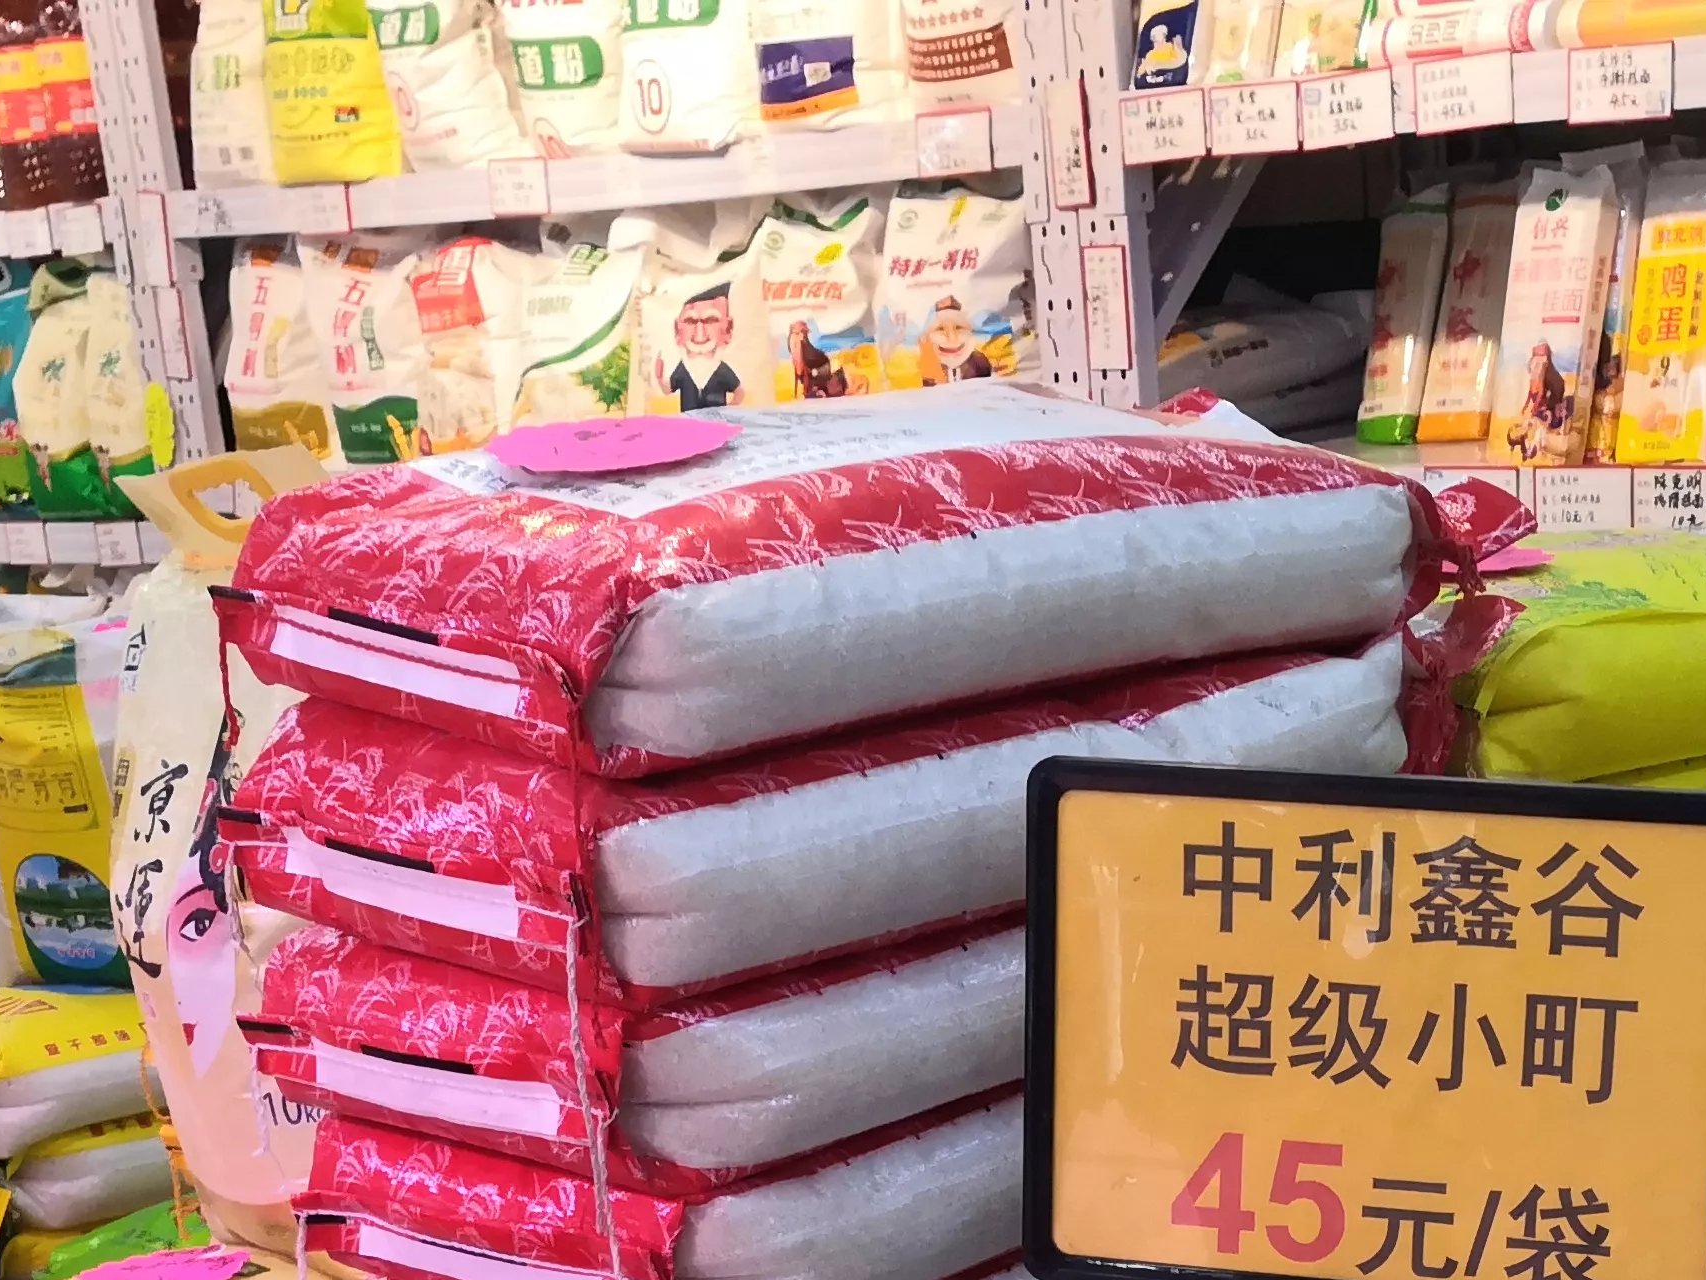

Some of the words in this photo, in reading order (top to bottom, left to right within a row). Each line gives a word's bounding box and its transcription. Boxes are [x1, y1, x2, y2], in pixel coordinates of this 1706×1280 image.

[637, 78, 661, 118] 10
[1657, 264, 1687, 342] 鸡蛋
[1182, 821, 1645, 959] 中利鑫谷
[1170, 966, 1639, 1105] 超级小町
